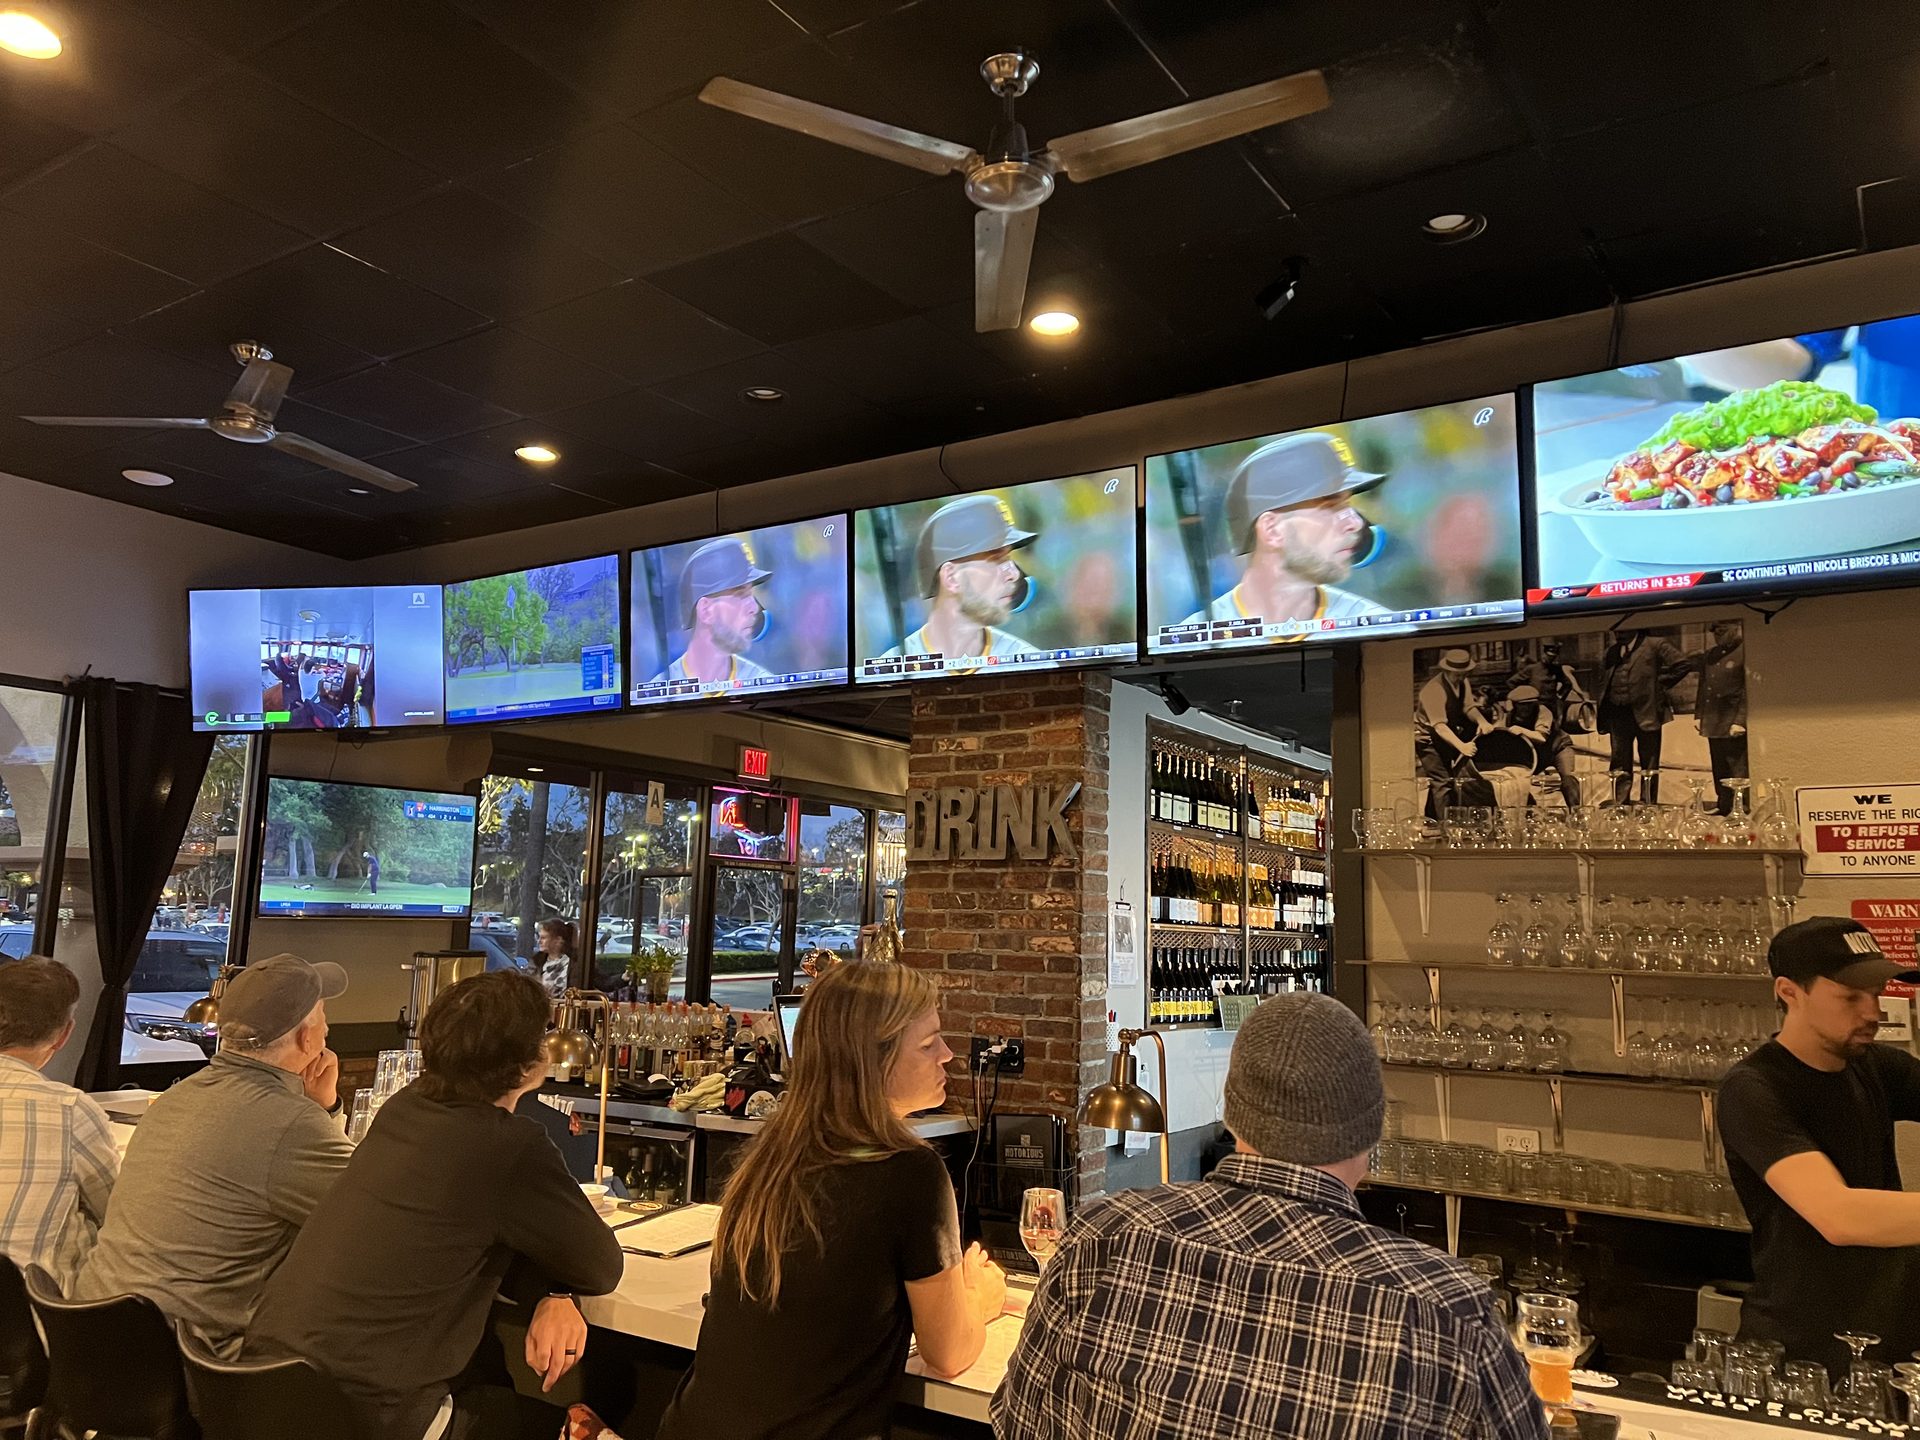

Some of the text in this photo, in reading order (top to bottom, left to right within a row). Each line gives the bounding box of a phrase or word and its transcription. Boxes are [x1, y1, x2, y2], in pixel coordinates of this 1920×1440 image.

[1722, 551, 1920, 582] SC CONTINUES WITH NICOLE BRISCOE & MIC
[1600, 575, 1691, 594] RETURNS IN 3:35
[744, 749, 768, 776] EXIT
[650, 788, 660, 808] A
[1854, 794, 1893, 805] WE
[906, 782, 1082, 861] DRINK
[1808, 810, 1866, 822] RESERVE
[1872, 808, 1896, 820] THE
[1832, 824, 1920, 838] TO REFUSE
[1846, 838, 1906, 850] SERVICE
[1840, 854, 1916, 866] TO ANYONE
[1868, 904, 1920, 918] WARN
[1867, 926, 1902, 934] hemicals
[1004, 1147, 1044, 1160] NOTORIOUS
[1666, 1384, 1910, 1431] WHITE CLAW
